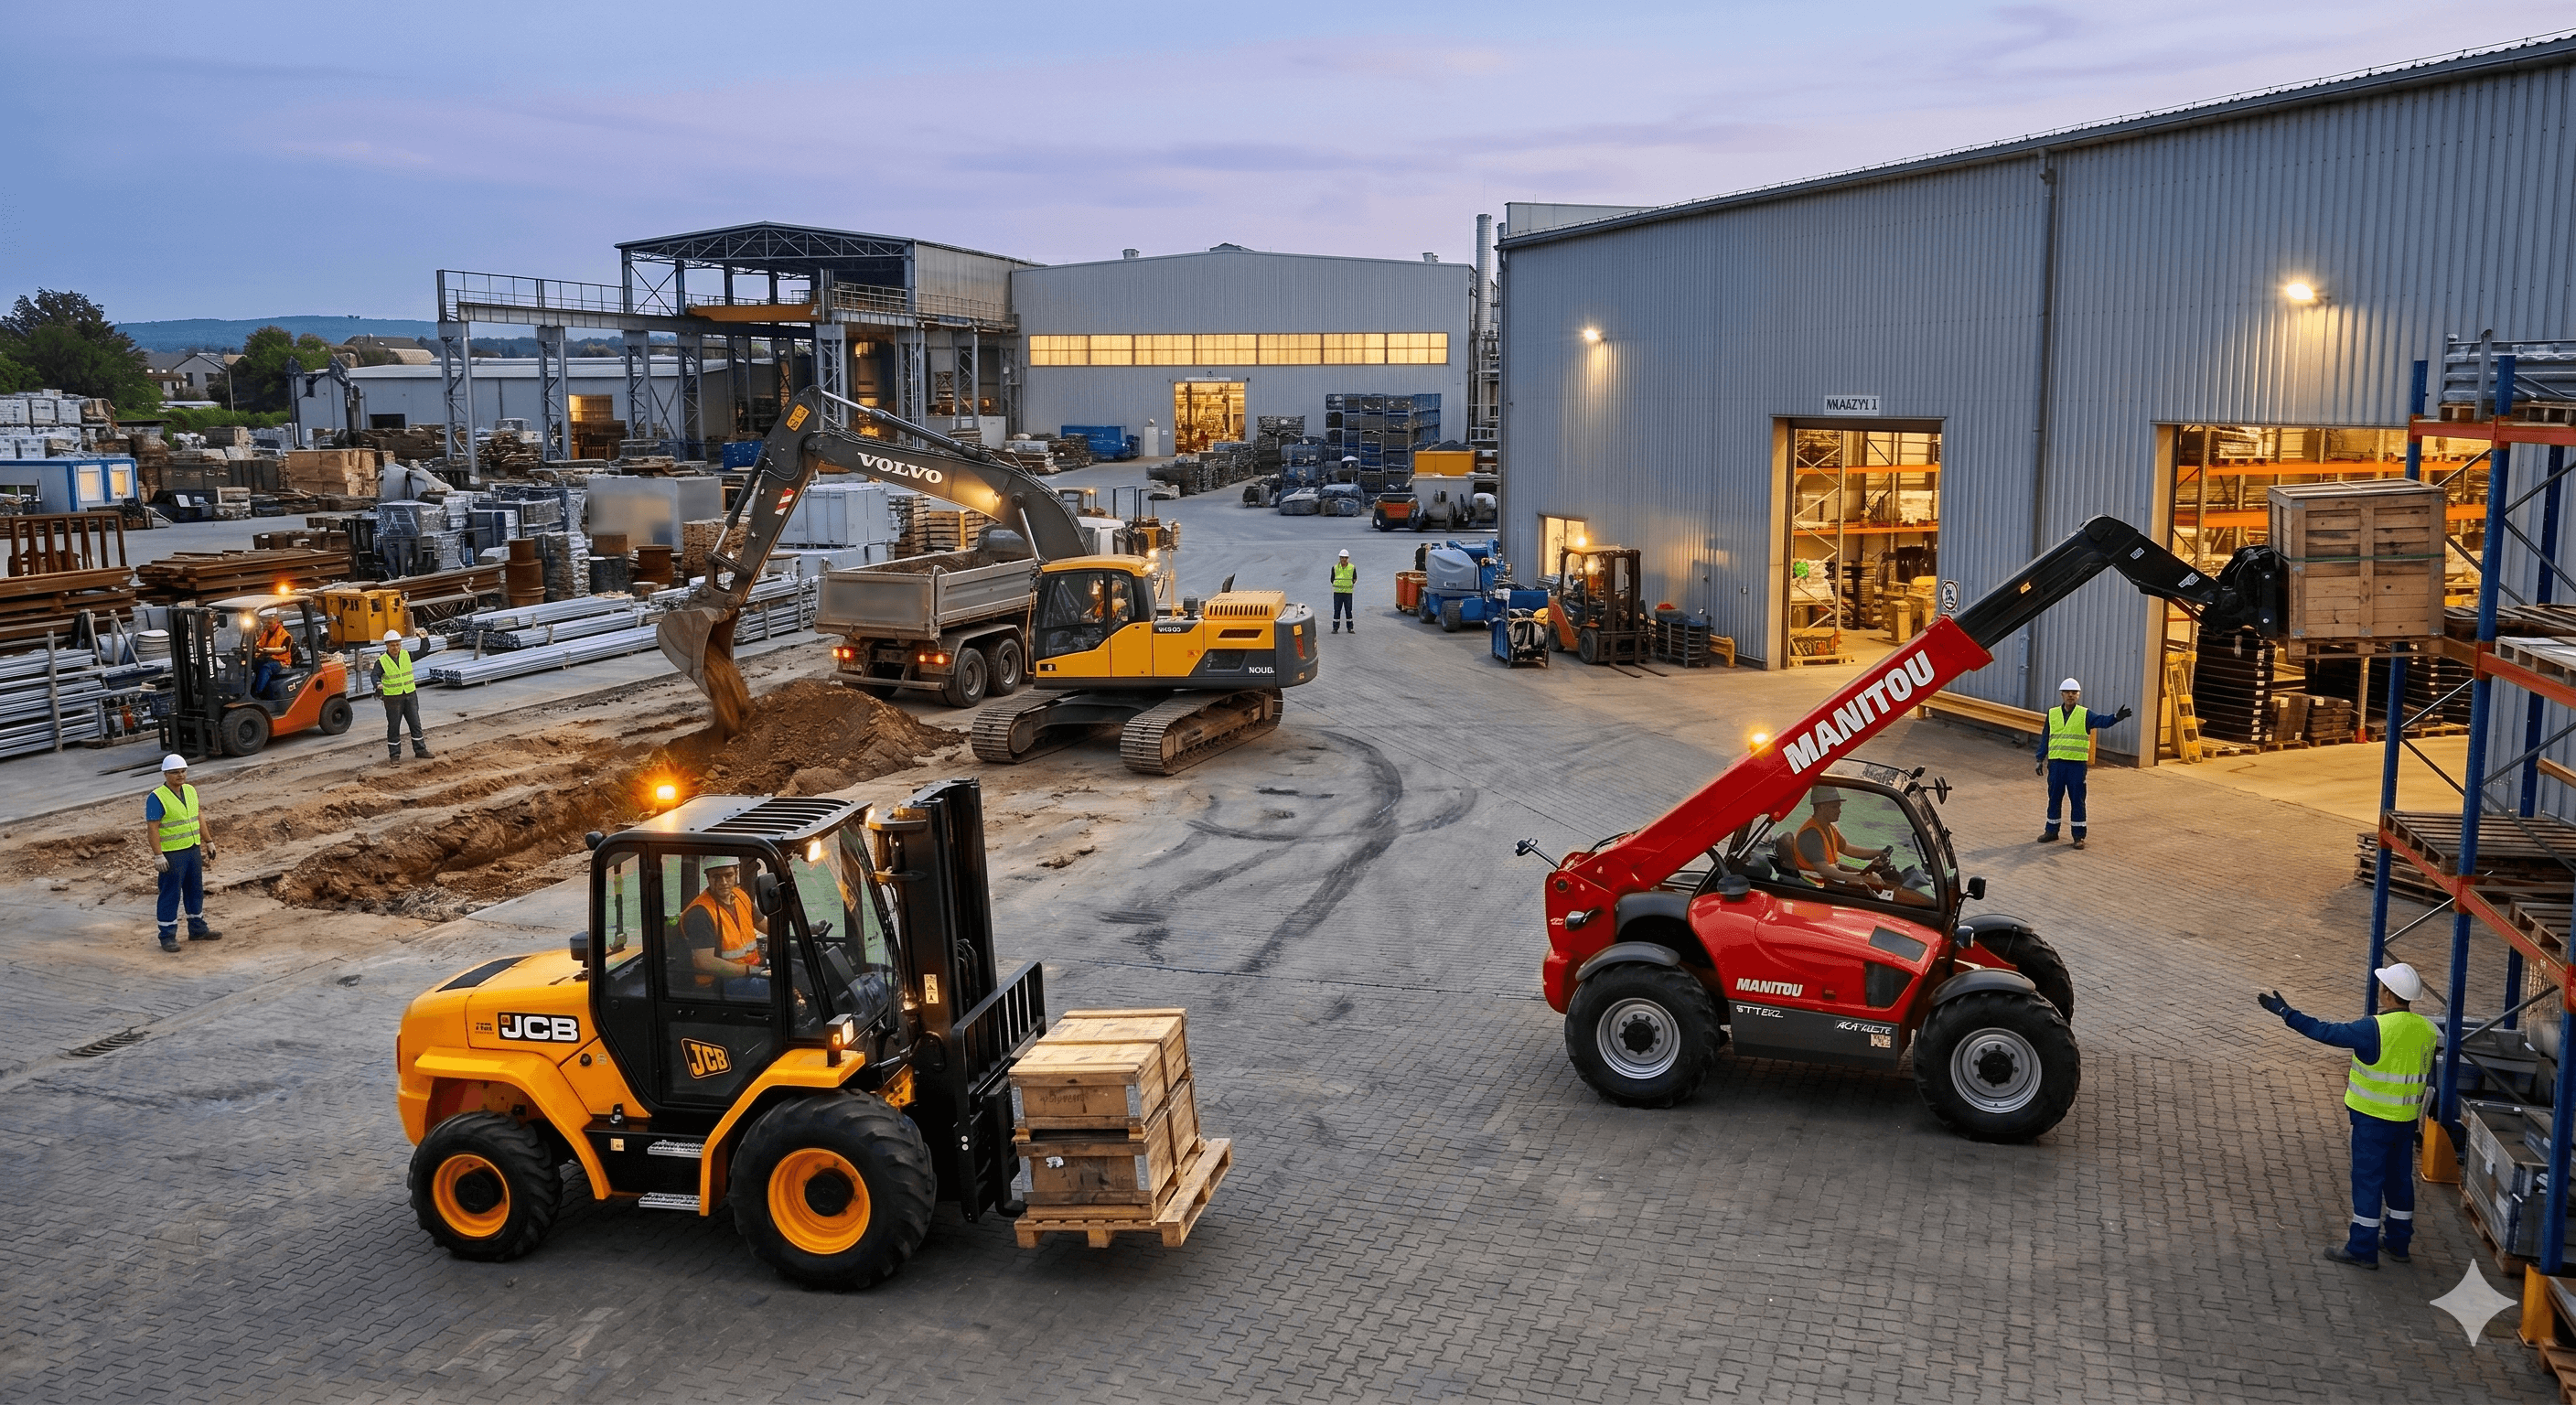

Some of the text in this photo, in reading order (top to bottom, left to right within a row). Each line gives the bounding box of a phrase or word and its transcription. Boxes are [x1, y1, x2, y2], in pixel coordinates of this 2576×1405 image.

[857, 452, 943, 484] VOLVO
[1782, 649, 1935, 775] MANITOU
[1736, 978, 1803, 997] MANITOU
[501, 1015, 578, 1042] JCB
[691, 1043, 728, 1076] JCB
